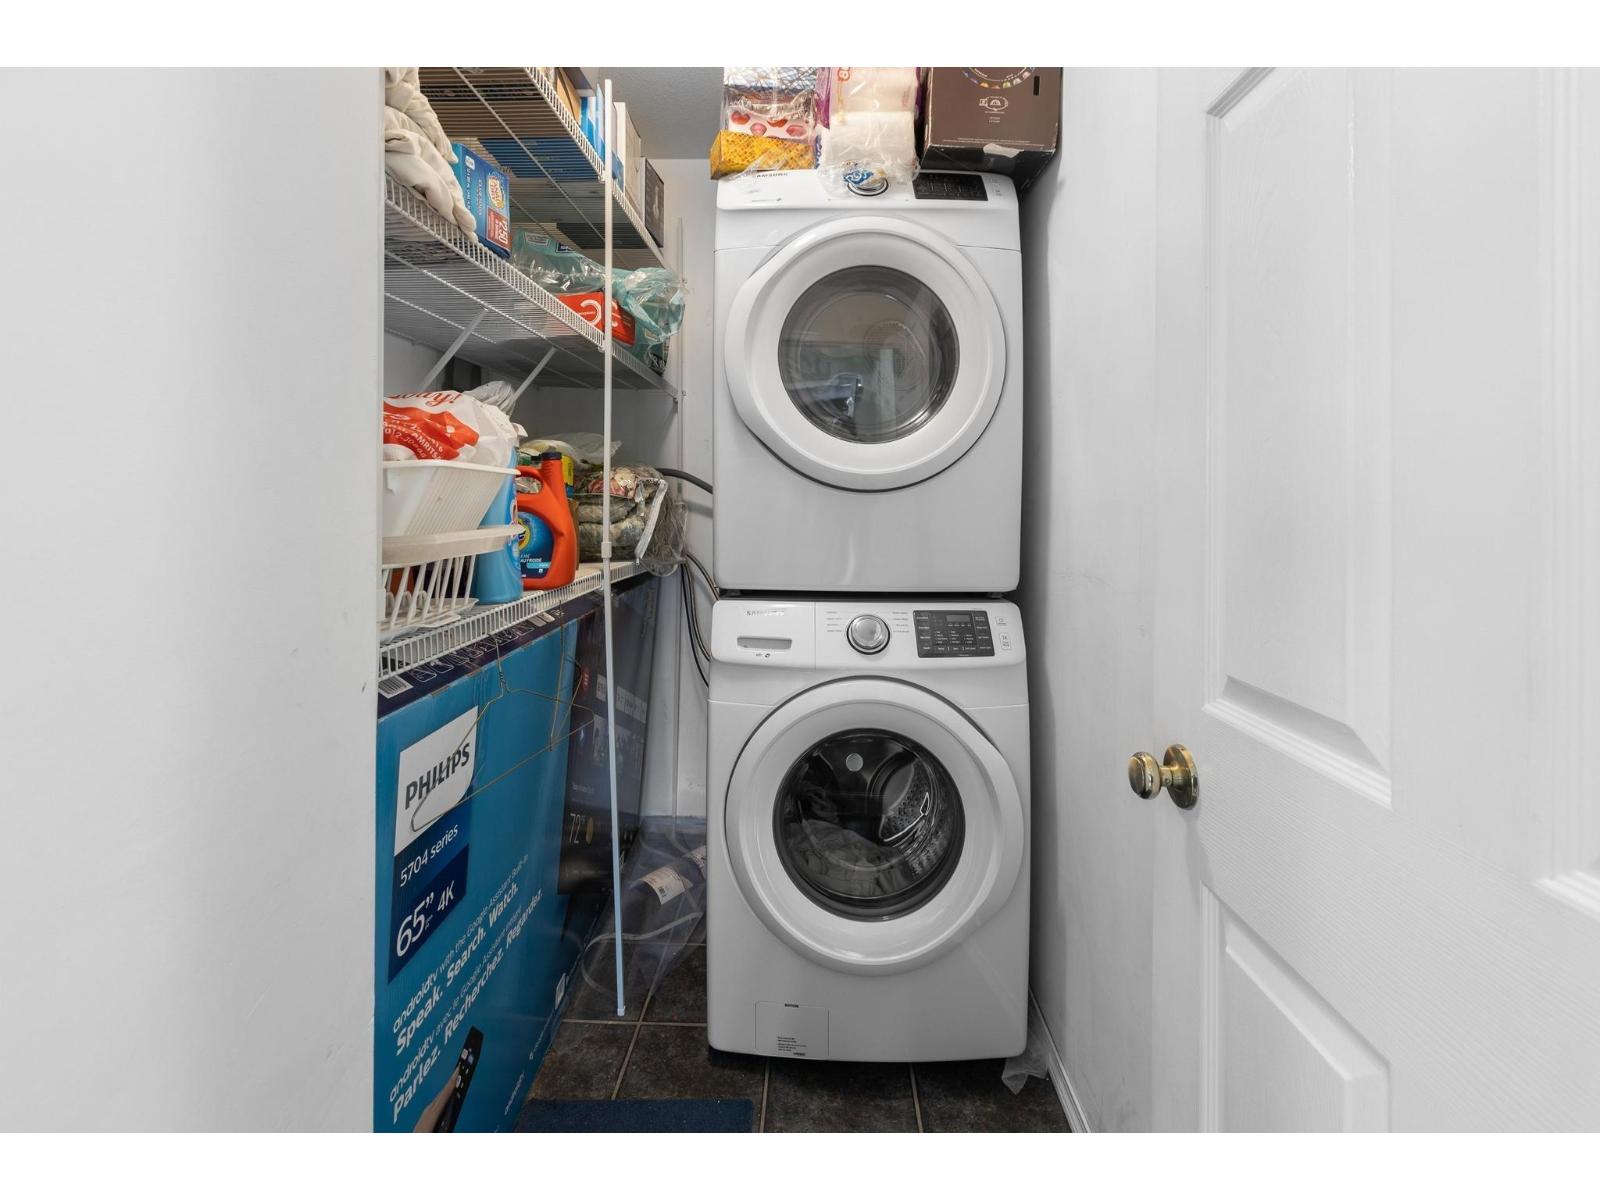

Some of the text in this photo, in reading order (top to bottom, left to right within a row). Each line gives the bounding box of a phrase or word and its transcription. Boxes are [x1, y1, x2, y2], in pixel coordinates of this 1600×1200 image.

[404, 742, 470, 810] PHILIPS
[400, 824, 458, 888] 5704 series
[437, 880, 455, 912] 4K
[396, 882, 519, 1056] Speak. Search. Watch.
[393, 888, 543, 1125] Parlez. Recherchez. Regardez.
